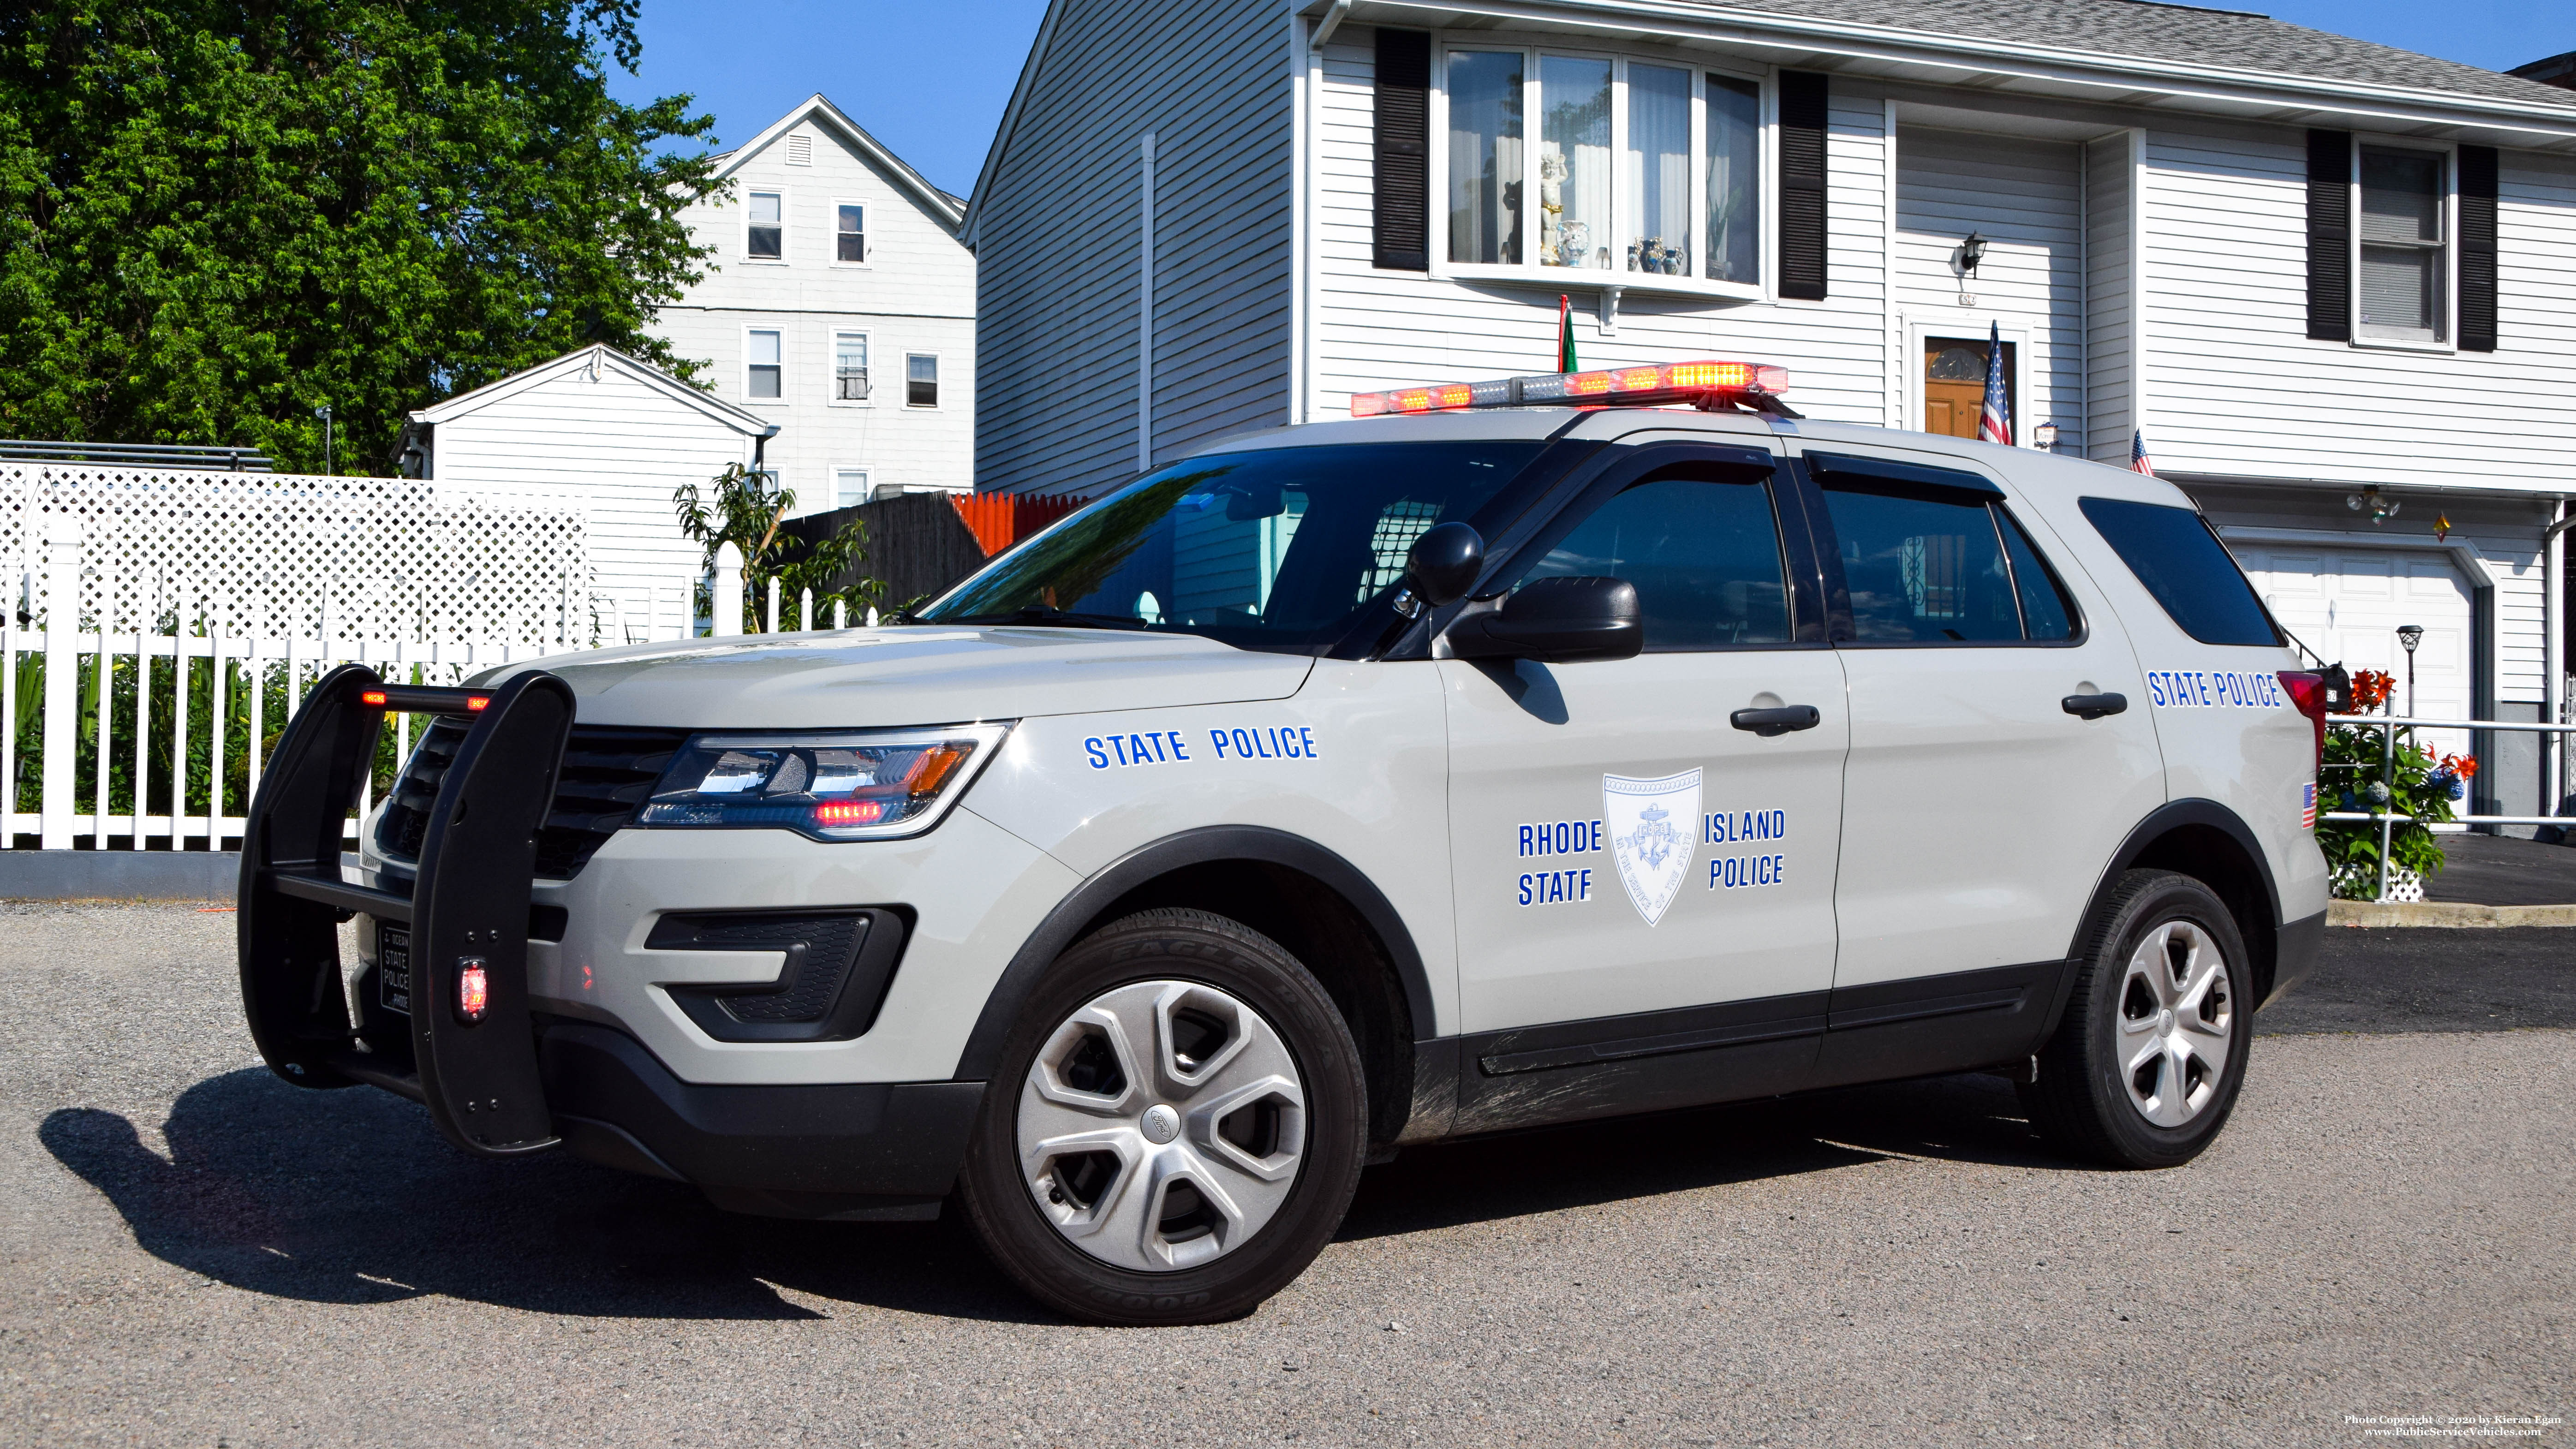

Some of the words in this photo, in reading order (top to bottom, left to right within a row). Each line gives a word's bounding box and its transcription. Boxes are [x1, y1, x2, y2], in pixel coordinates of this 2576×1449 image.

[2147, 670, 2212, 708] STATE
[2212, 671, 2281, 709] POLICE
[1084, 730, 1192, 771] STATE
[1208, 725, 1319, 760] POLICE
[1518, 819, 1602, 858] RHODE
[1704, 808, 1785, 845] ISLAND
[1643, 824, 1665, 835] HOPE
[1616, 835, 1624, 849] IN
[1620, 850, 1632, 874] THE
[1628, 873, 1652, 911] SERVICE
[1655, 893, 1665, 909] OF
[1665, 870, 1679, 891] THE
[1677, 831, 1692, 867] STATE
[1709, 854, 1784, 890] POLICE
[392, 934, 409, 947] OCEAN
[385, 949, 406, 969] STATE
[1110, 940, 1258, 969] EAGLE
[384, 969, 409, 990] POLICE
[394, 993, 408, 1008] RHODE
[1152, 1115, 1169, 1134] Ford
